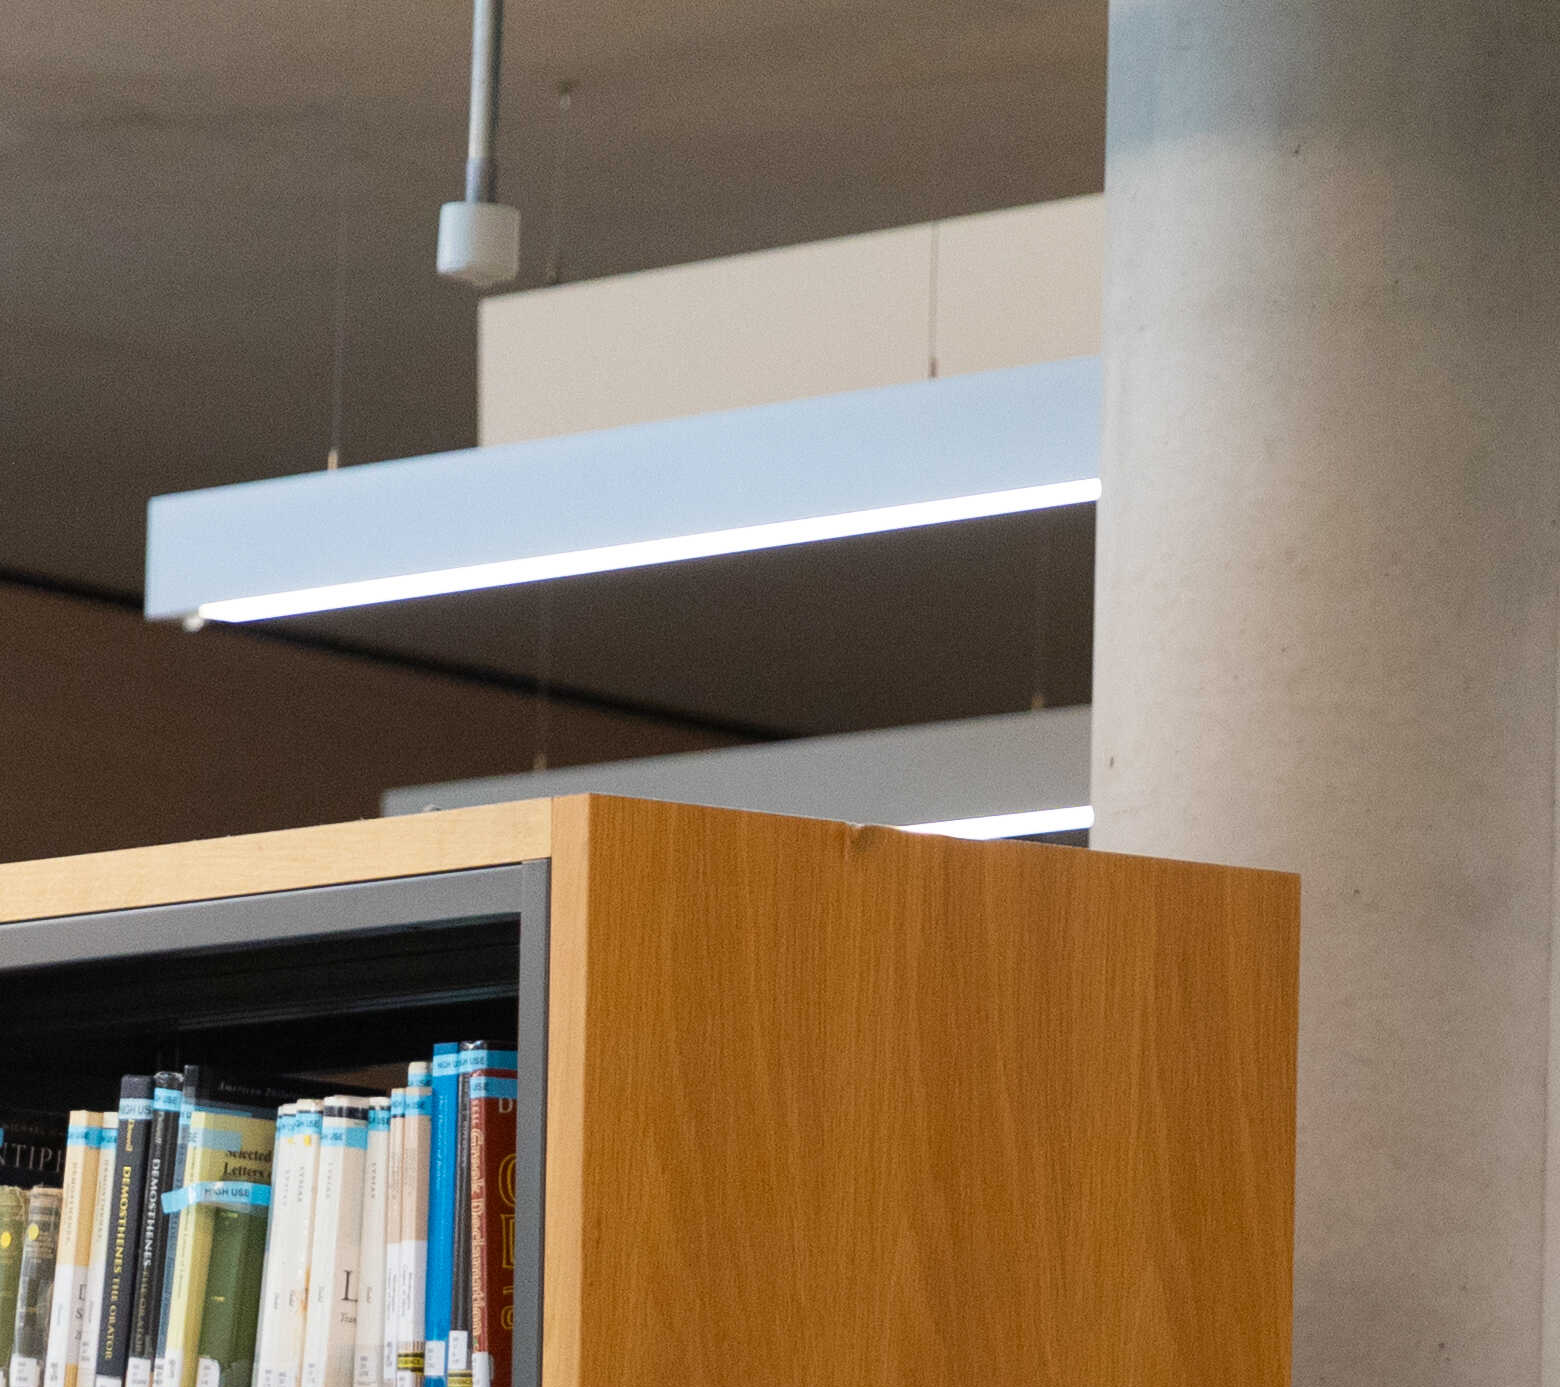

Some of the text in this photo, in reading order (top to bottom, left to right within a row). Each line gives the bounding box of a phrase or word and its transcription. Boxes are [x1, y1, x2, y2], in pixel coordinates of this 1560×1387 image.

[113, 1165, 132, 1275] DEMOSTHENES
[142, 1157, 162, 1268] DEMOSTHENES
[230, 1187, 251, 1198] USE
[104, 1307, 119, 1361] ORATOR
